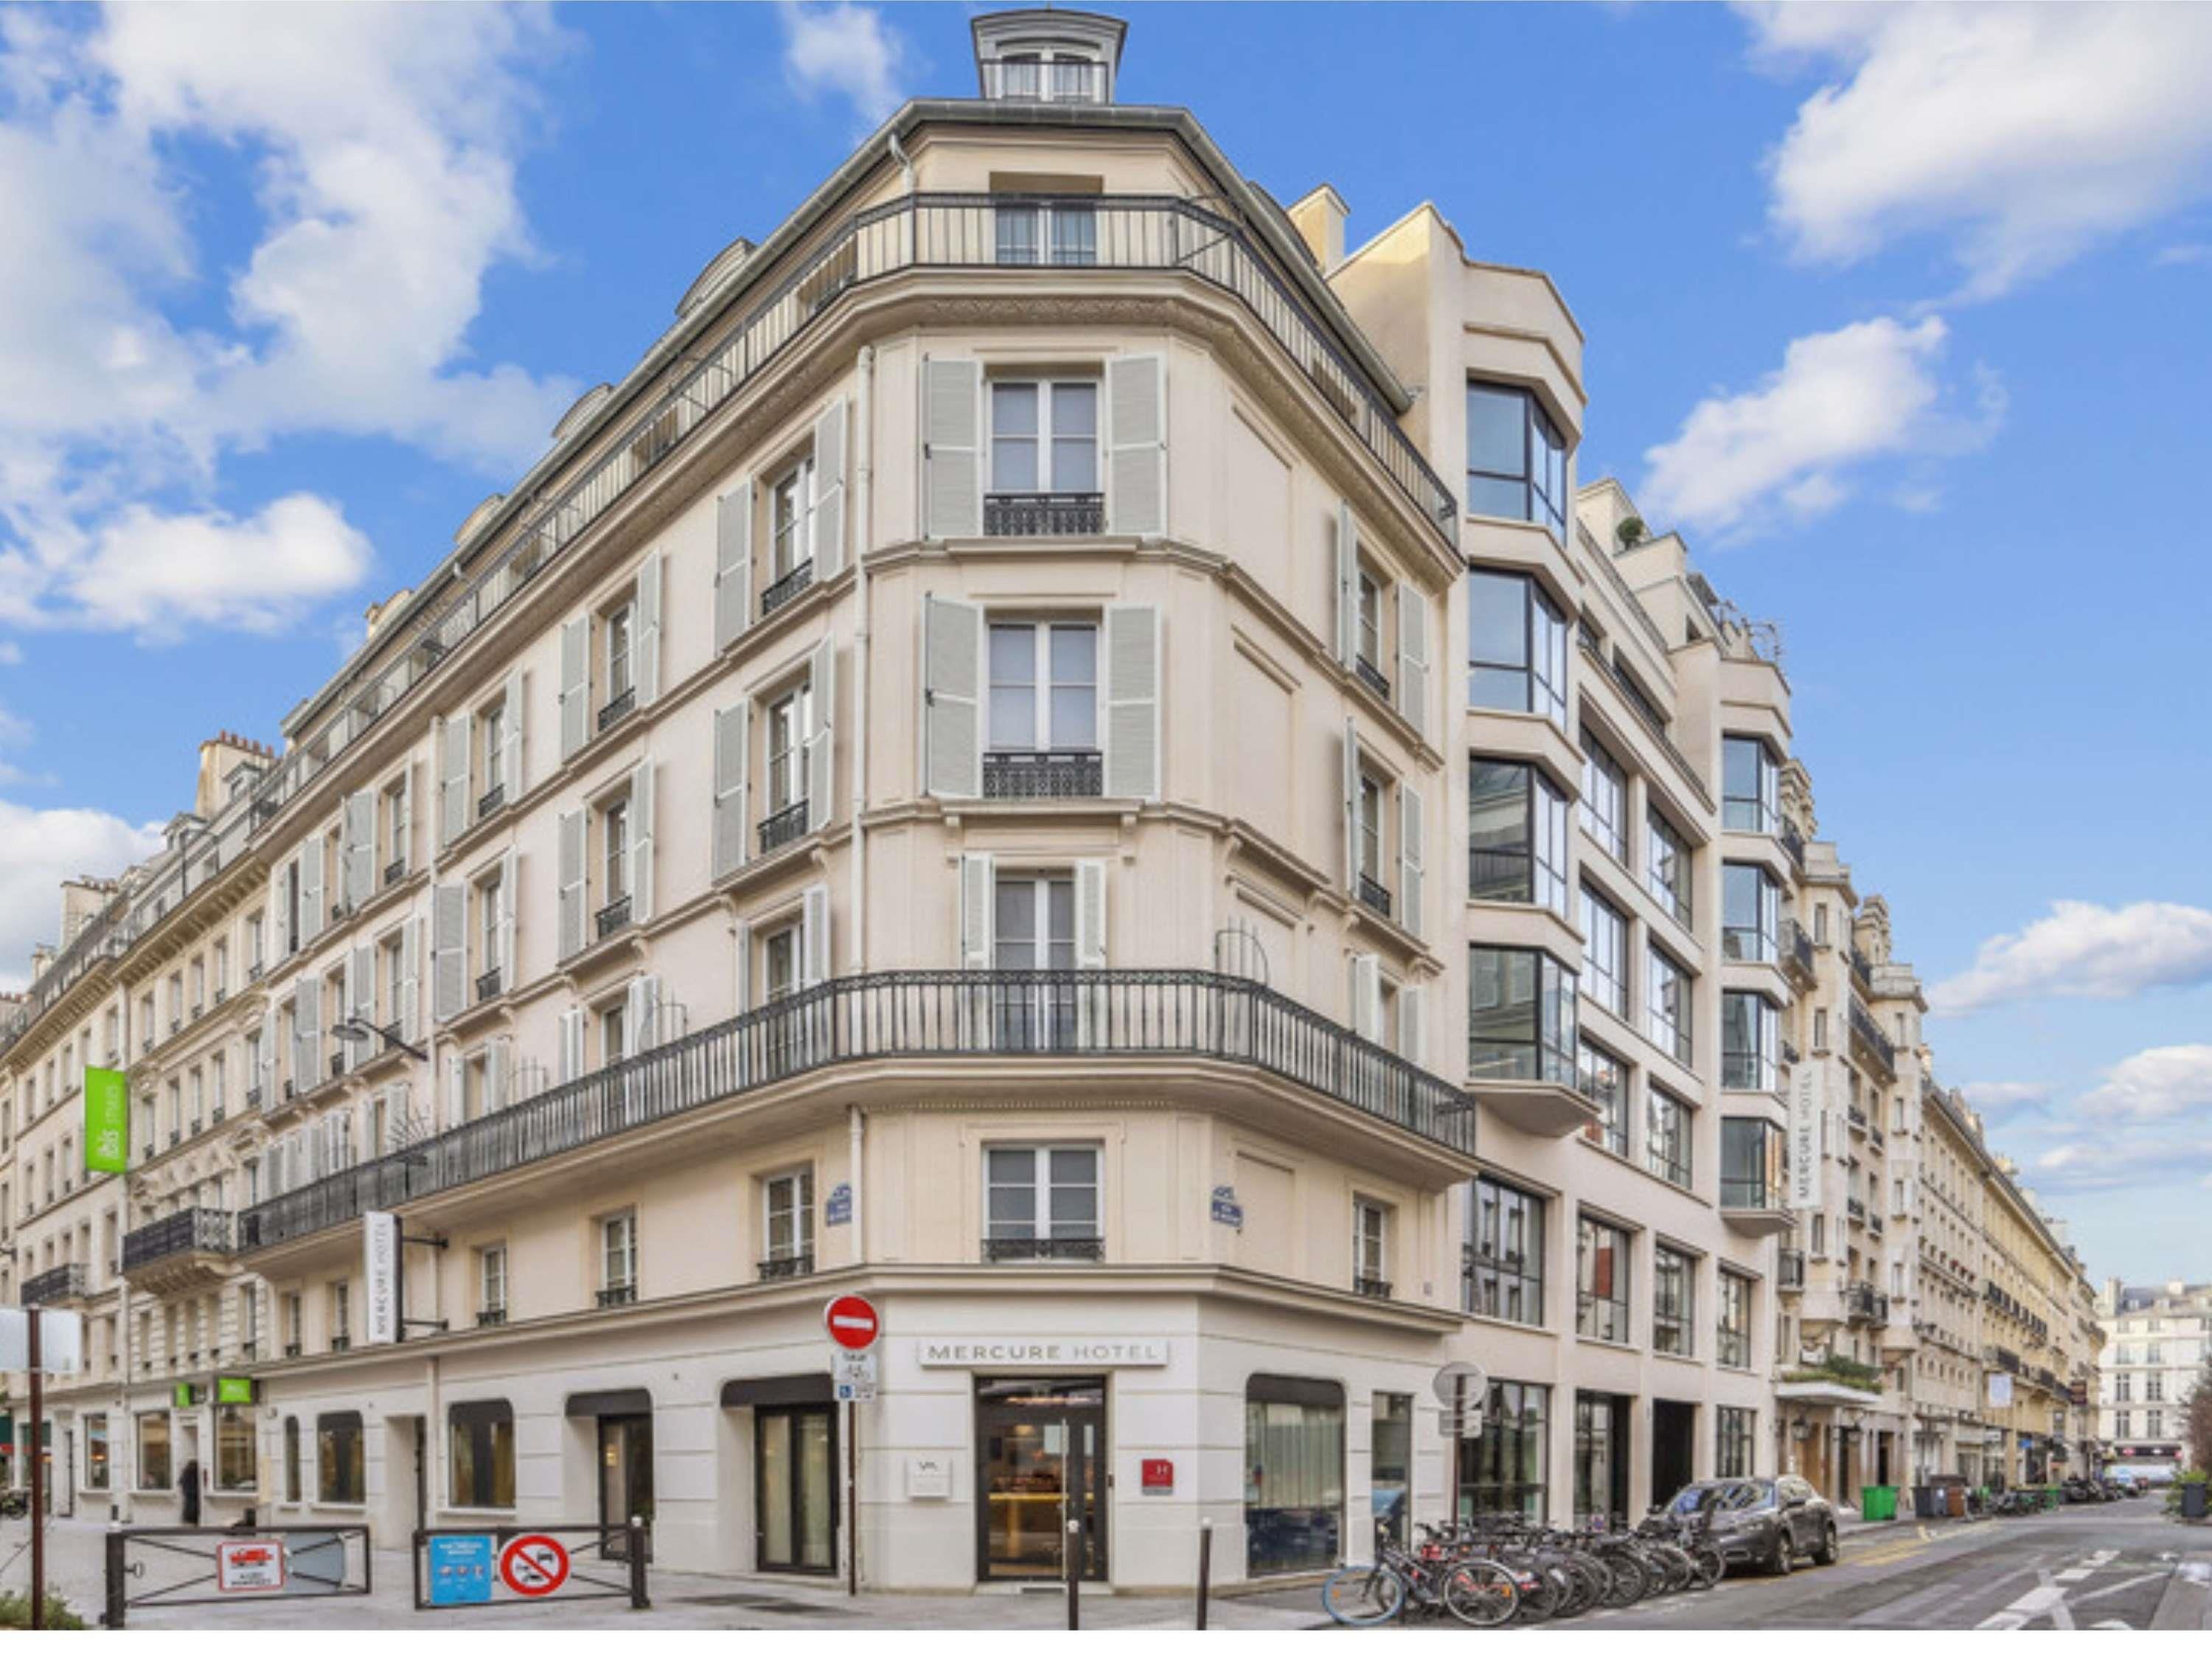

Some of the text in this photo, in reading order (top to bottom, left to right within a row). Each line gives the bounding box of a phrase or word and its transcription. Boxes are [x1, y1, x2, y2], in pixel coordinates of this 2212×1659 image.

[1799, 1126, 1812, 1198] MERCURE
[928, 1345, 1158, 1360] MERCURE HOTEL
